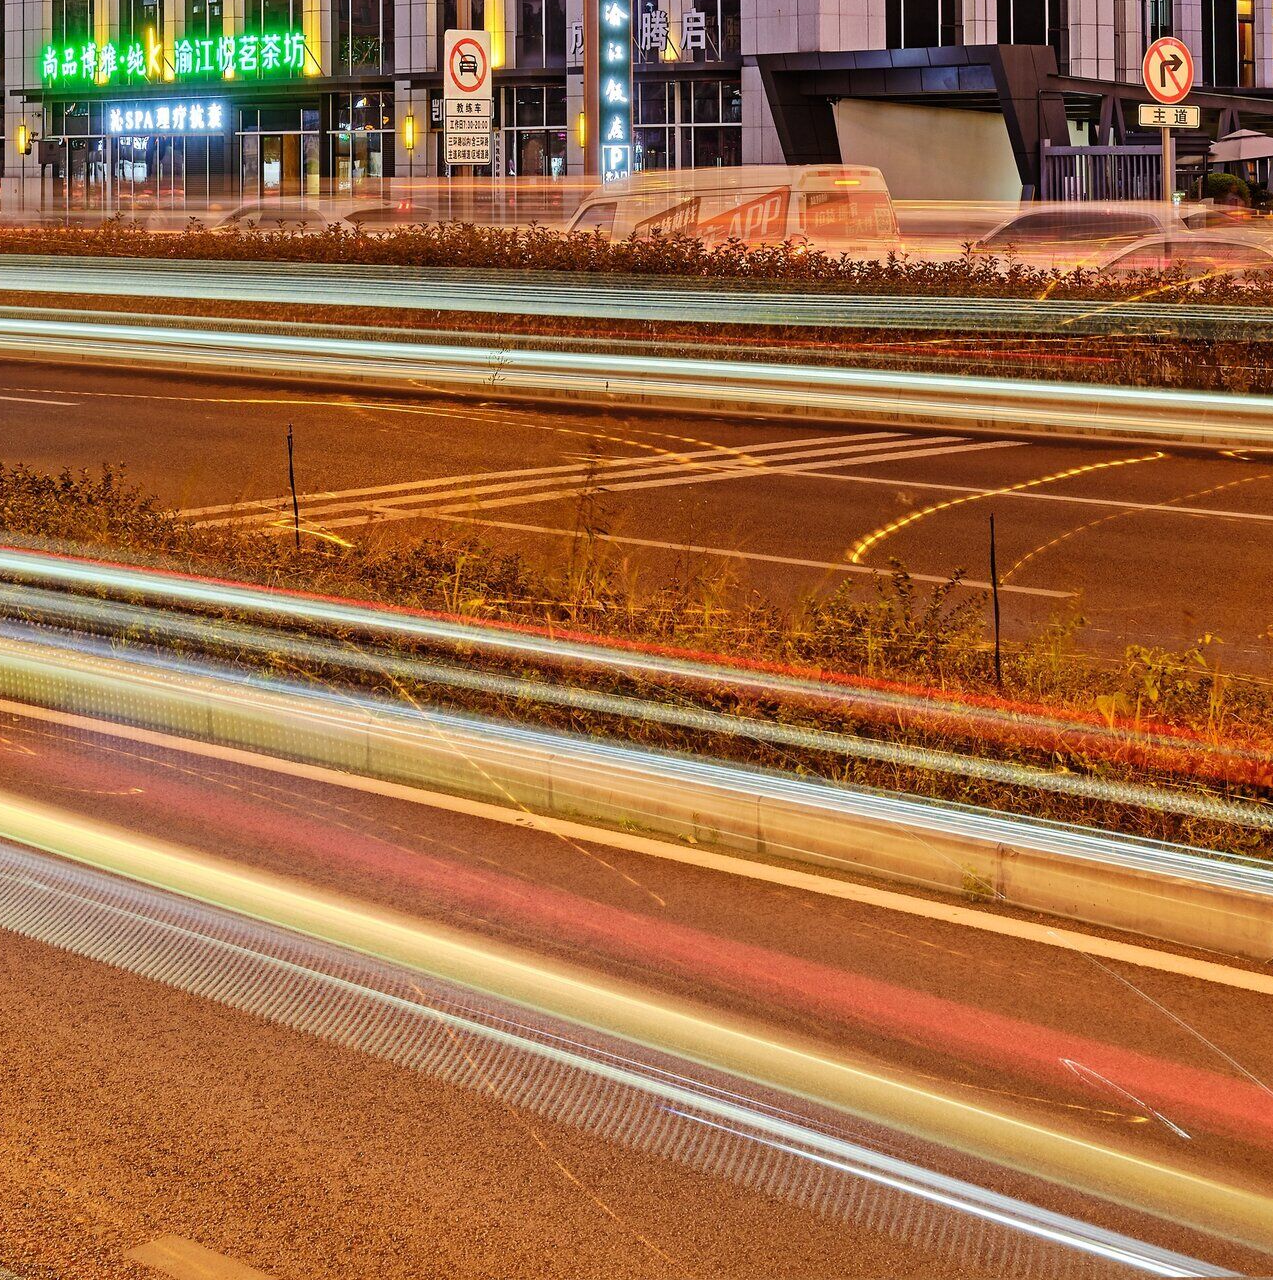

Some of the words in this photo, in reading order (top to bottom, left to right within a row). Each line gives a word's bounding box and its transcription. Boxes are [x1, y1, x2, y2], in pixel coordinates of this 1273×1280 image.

[174, 32, 306, 74] 渝江悦茗茶坊
[456, 102, 482, 114] 教练车
[1152, 108, 1188, 124] 主道
[610, 147, 623, 169] P
